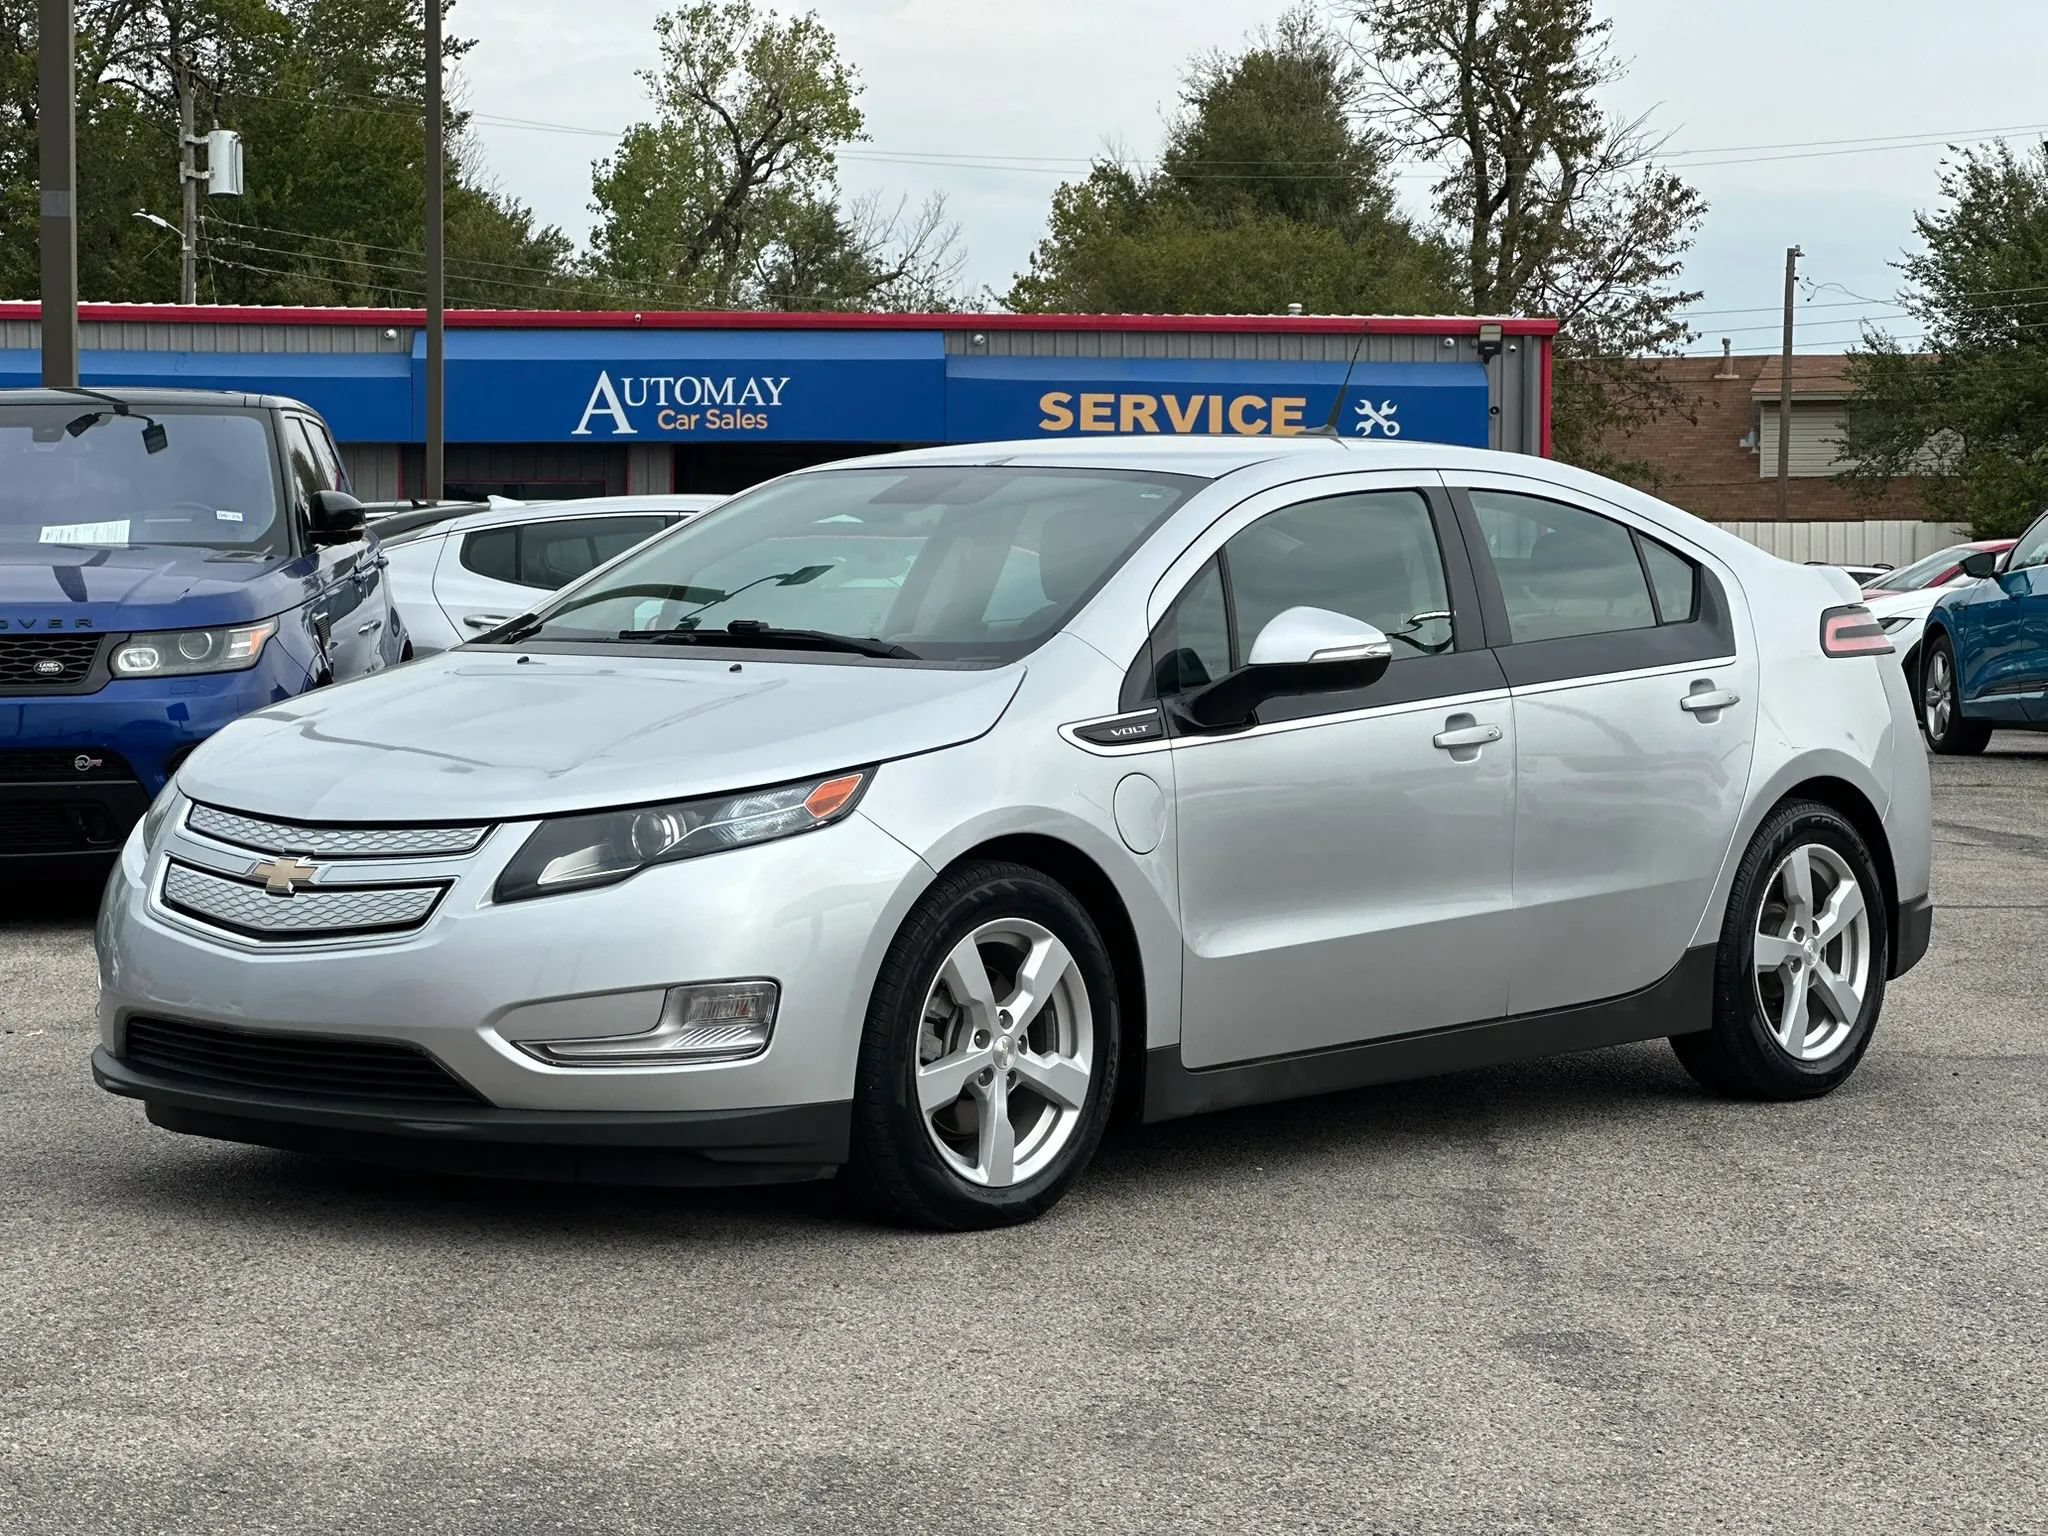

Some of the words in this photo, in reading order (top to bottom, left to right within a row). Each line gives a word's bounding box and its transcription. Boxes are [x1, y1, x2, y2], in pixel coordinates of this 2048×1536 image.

[571, 370, 790, 435] AUTOMAY
[657, 409, 700, 431] Car
[705, 408, 768, 430] Sales
[1038, 391, 1307, 436] SERVICE
[1110, 724, 1149, 736] VOLT
